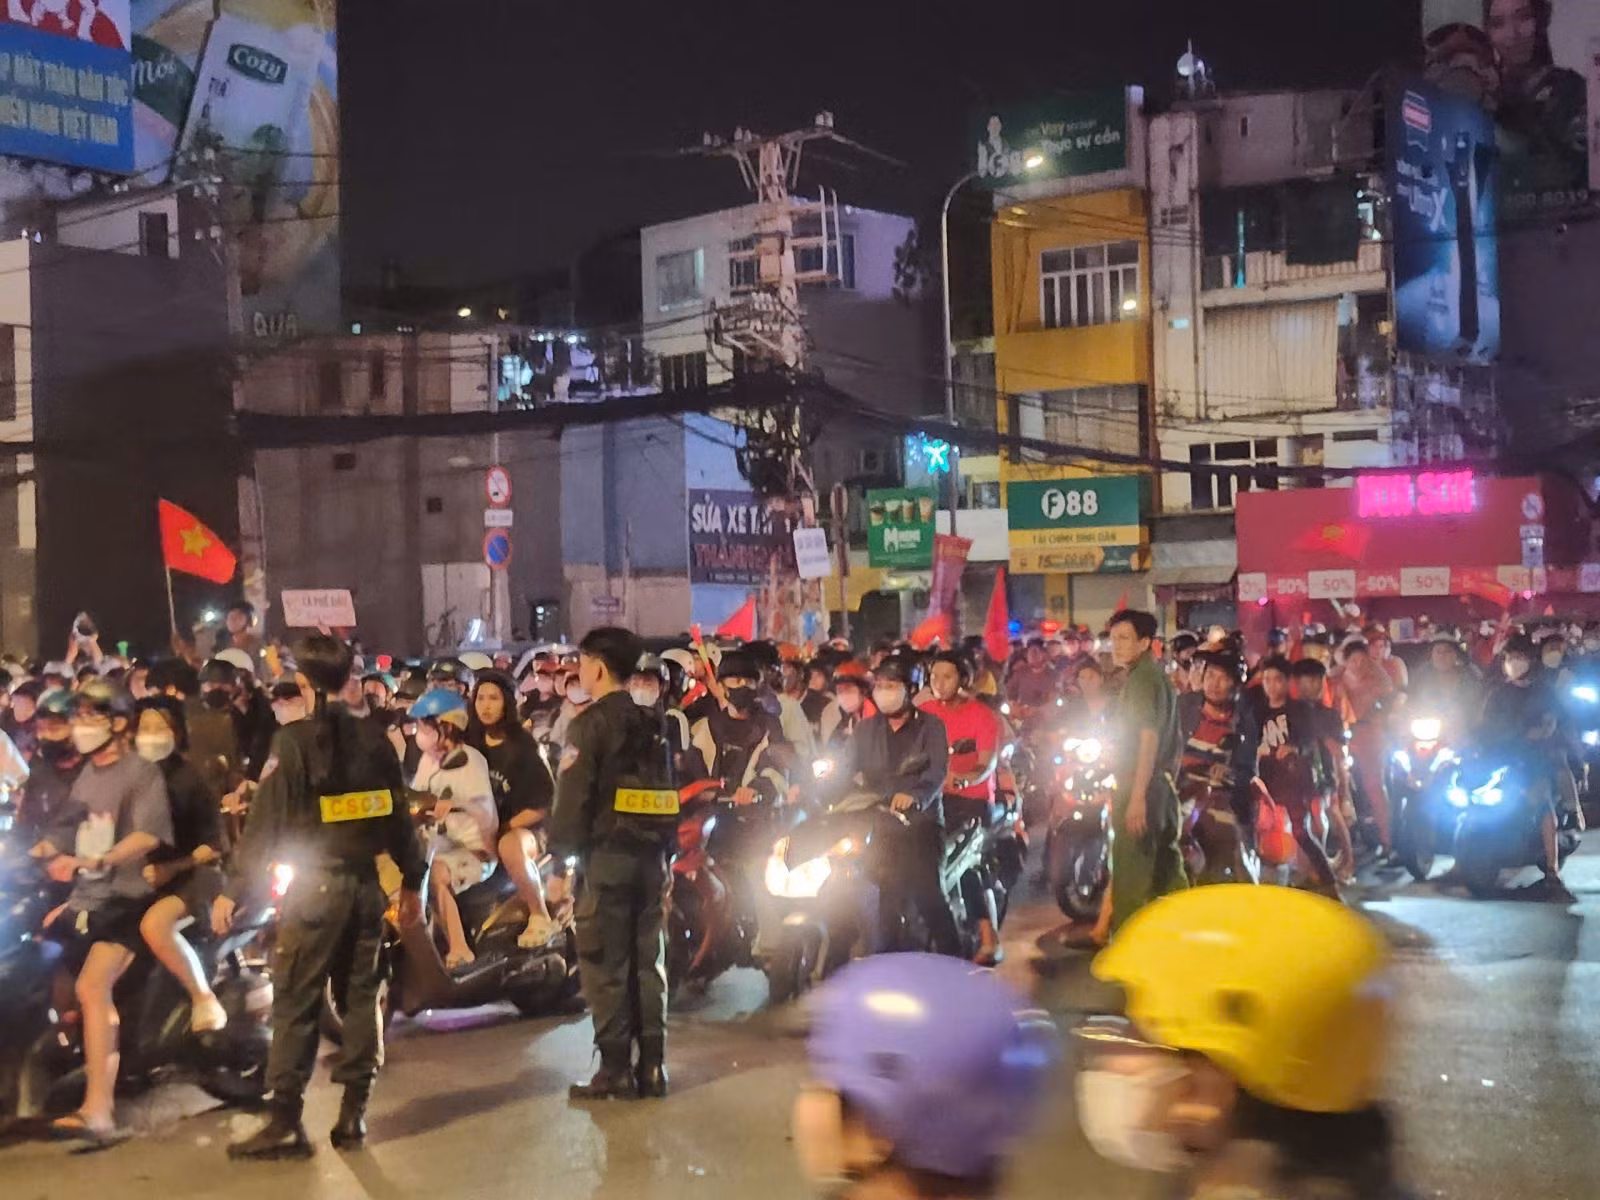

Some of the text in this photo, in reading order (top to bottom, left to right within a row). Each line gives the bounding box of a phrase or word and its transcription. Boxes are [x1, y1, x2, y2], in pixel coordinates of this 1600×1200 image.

[233, 47, 281, 80] Cozy
[727, 504, 747, 534] XE
[1041, 487, 1099, 520] F88
